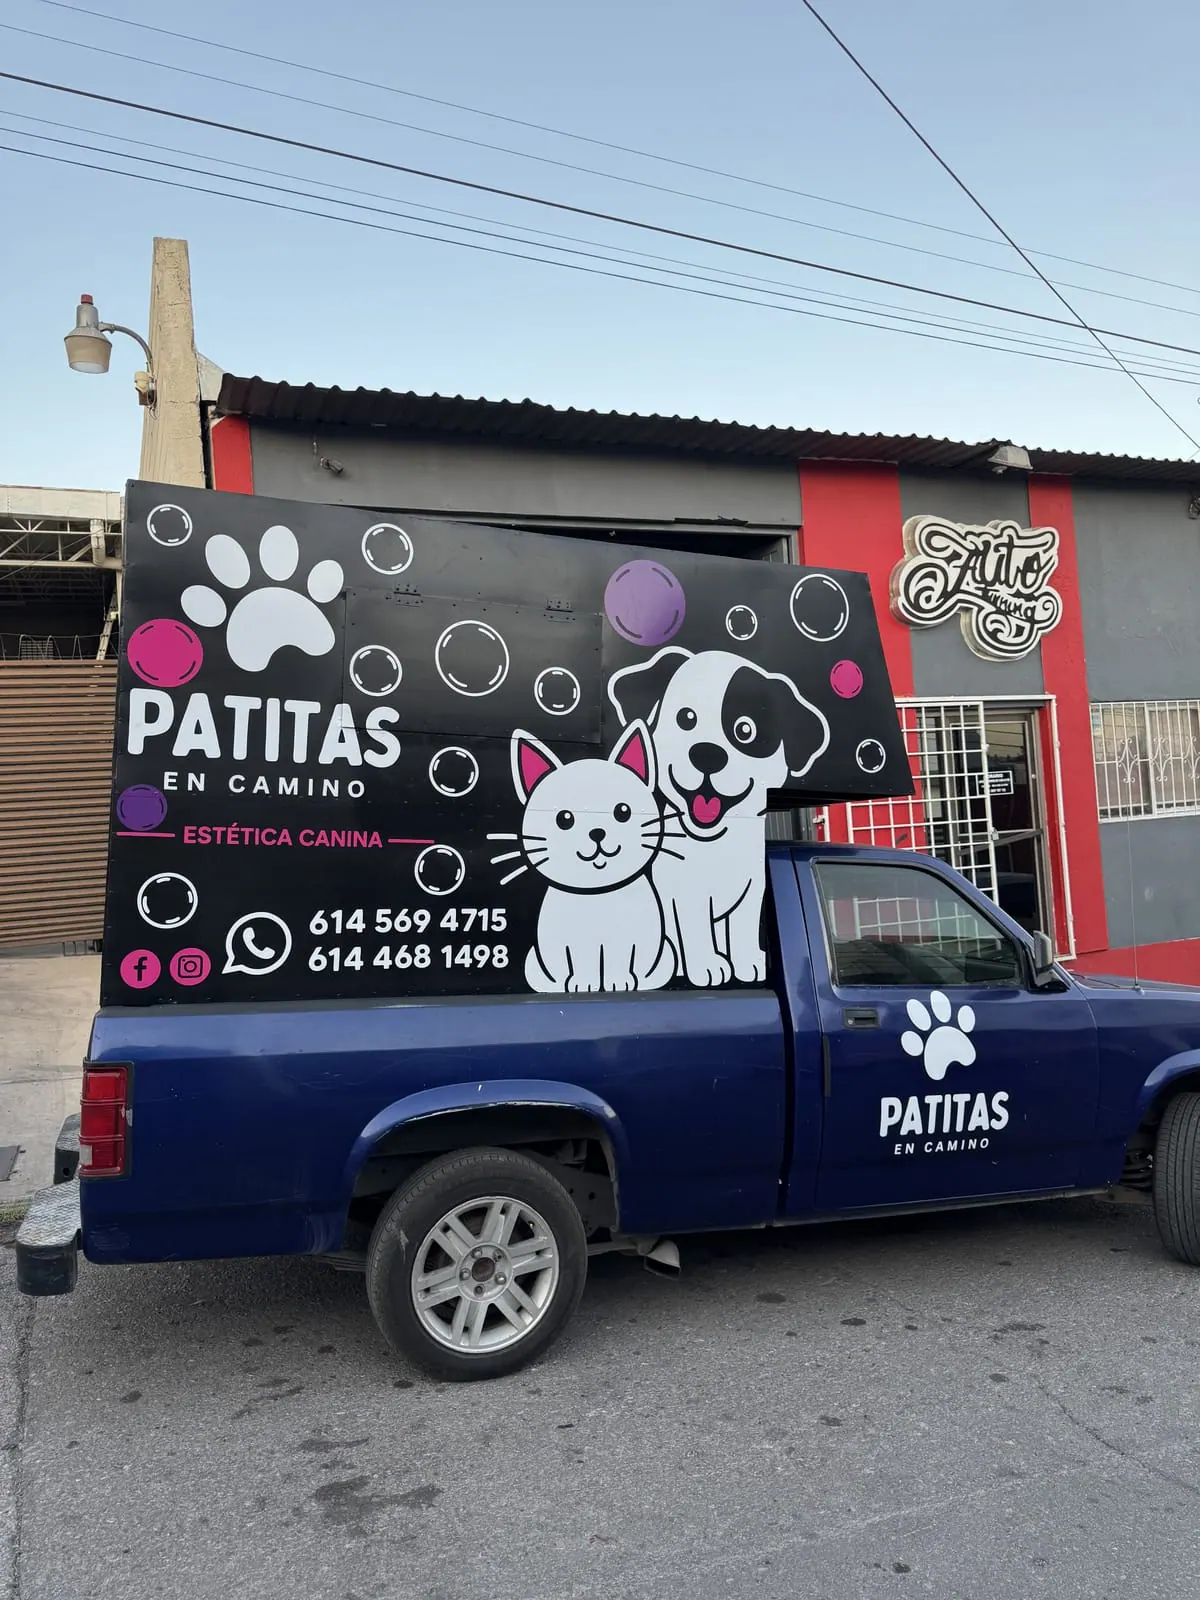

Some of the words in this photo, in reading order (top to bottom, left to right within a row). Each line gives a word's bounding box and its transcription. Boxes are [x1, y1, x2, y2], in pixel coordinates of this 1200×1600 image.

[902, 523, 1056, 614] Auto
[127, 688, 402, 768] PATITAS
[163, 771, 206, 792] EN
[228, 774, 366, 798] CAMINO
[183, 822, 293, 847] ESTÉTICA
[299, 829, 383, 848] CANINA
[309, 909, 366, 935] 614
[374, 908, 431, 933] 569
[439, 908, 508, 933] 4715
[308, 946, 364, 971] 614
[373, 944, 431, 970] 468
[440, 945, 509, 969] 1498
[879, 1091, 1010, 1138] PATITAS
[894, 1143, 916, 1155] EN
[924, 1137, 990, 1153] CAMINO
